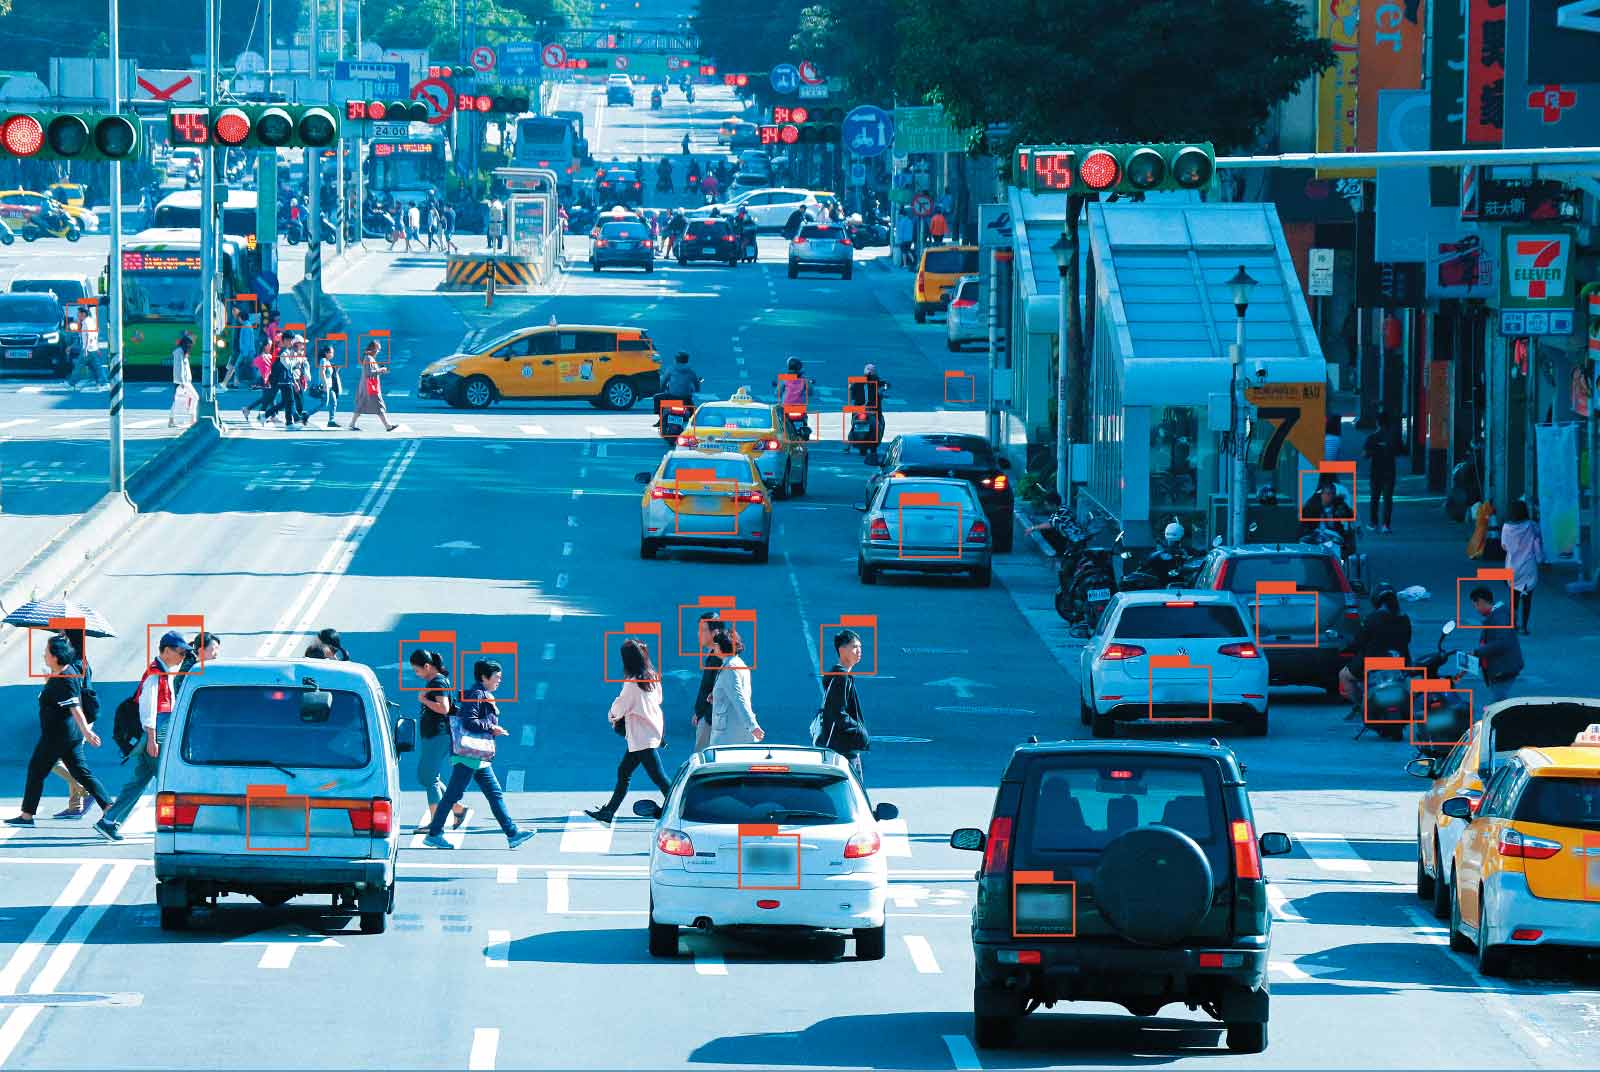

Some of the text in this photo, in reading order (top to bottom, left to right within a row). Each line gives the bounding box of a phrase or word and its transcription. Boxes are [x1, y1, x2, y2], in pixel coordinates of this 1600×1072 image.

[349, 103, 365, 120] 34
[458, 96, 473, 110] 34
[774, 108, 788, 123] 34
[173, 113, 208, 143] 45
[375, 126, 406, 136] 24:00
[761, 127, 778, 144] 34
[1035, 154, 1072, 189] 45
[1516, 240, 1561, 299] 7
[1256, 407, 1301, 471] 7
